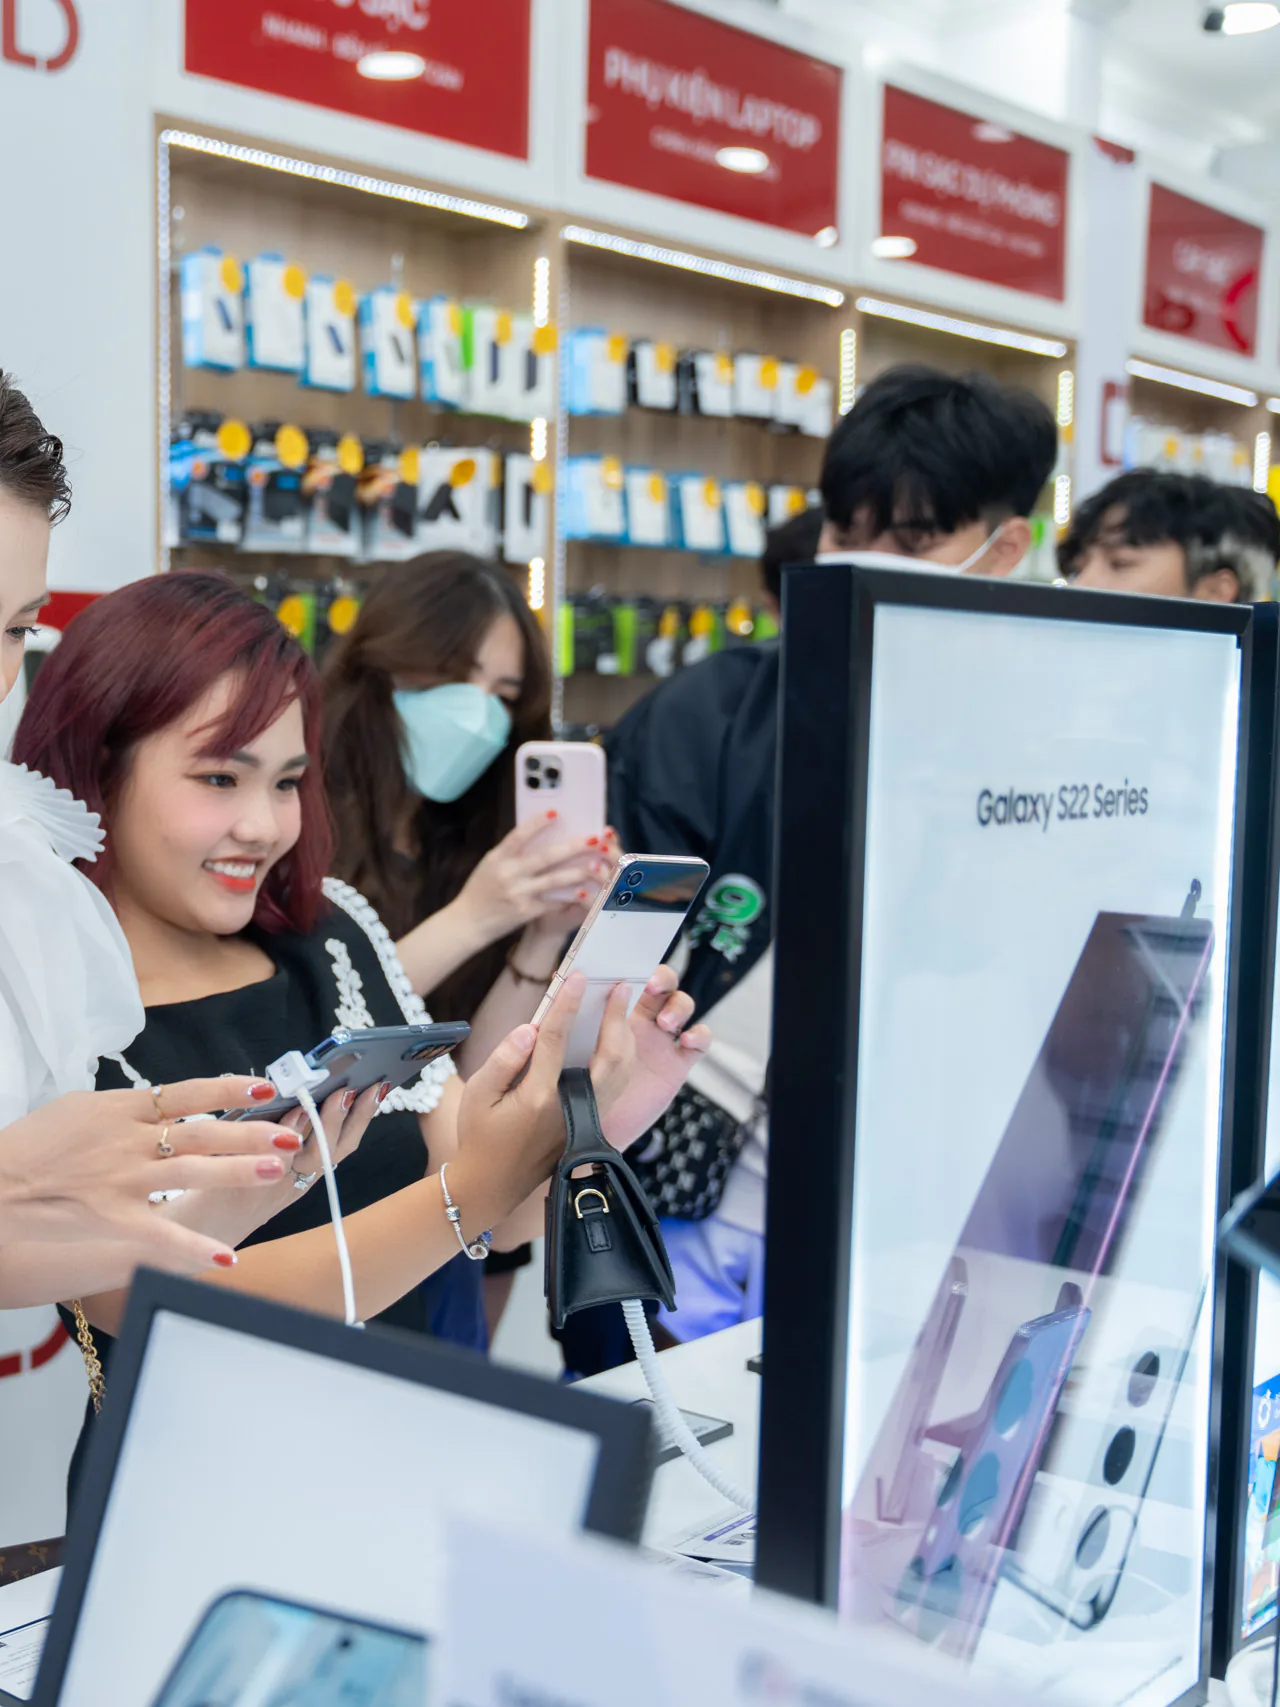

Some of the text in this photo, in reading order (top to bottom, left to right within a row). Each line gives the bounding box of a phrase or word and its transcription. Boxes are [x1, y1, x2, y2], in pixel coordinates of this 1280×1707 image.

[976, 776, 1148, 833] Galaxy S22 Series
